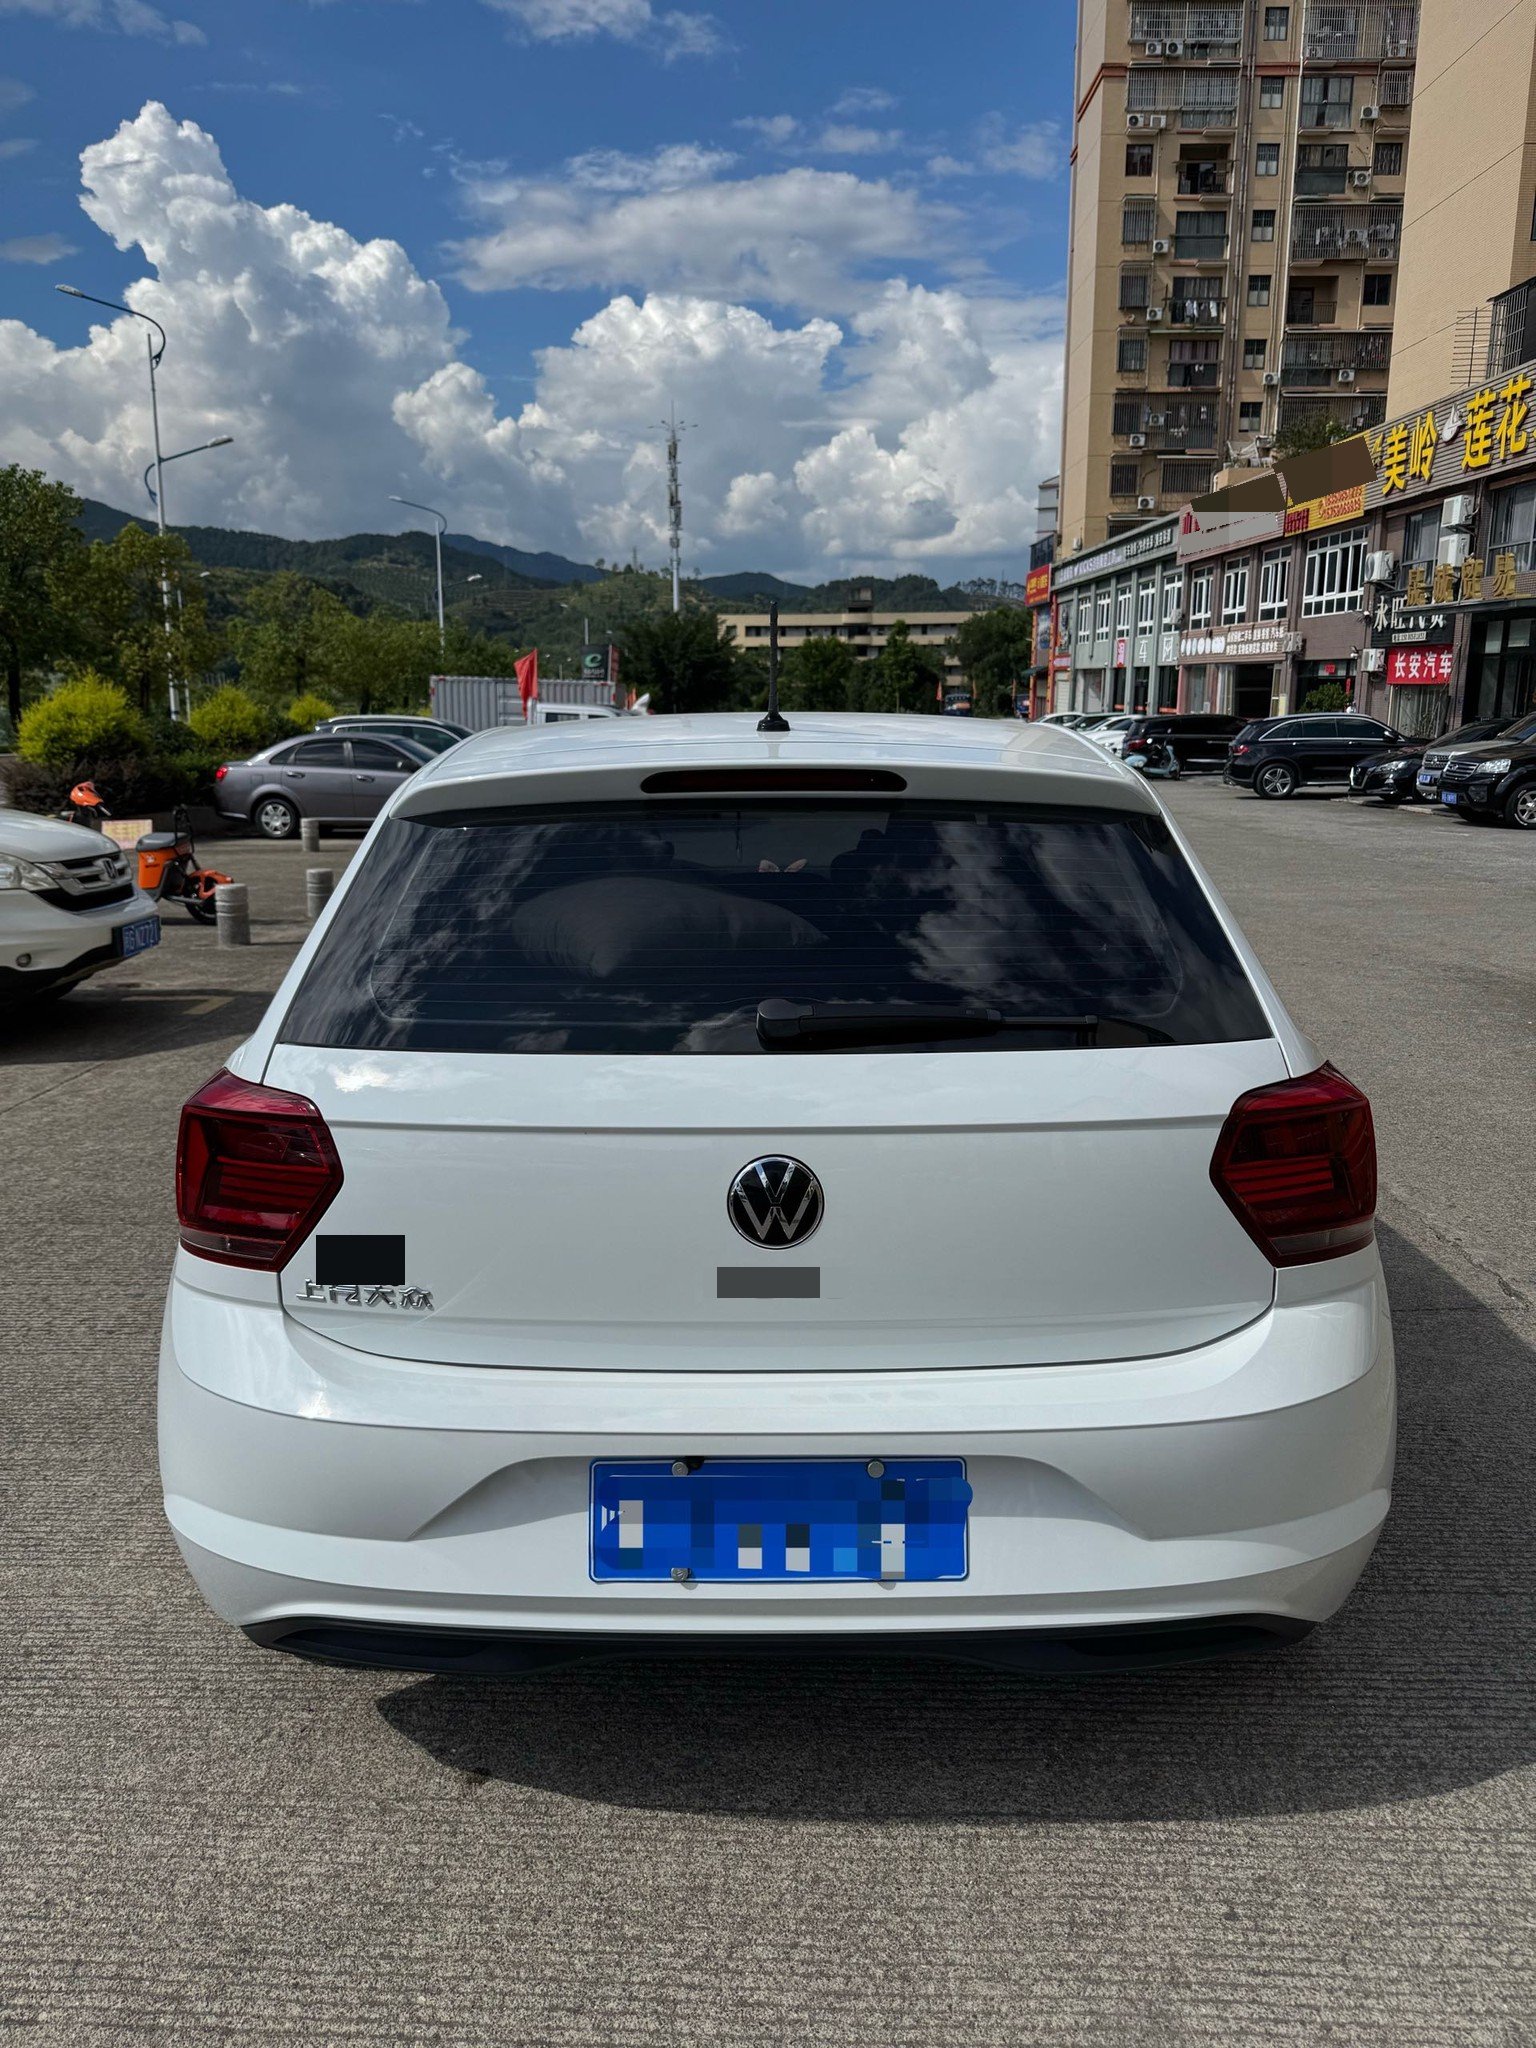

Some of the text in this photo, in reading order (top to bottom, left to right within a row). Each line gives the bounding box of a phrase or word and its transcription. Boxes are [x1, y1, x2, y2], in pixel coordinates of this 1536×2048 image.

[1382, 373, 1536, 495] 美岭 莲花
[1395, 651, 1452, 679] 长安汽车
